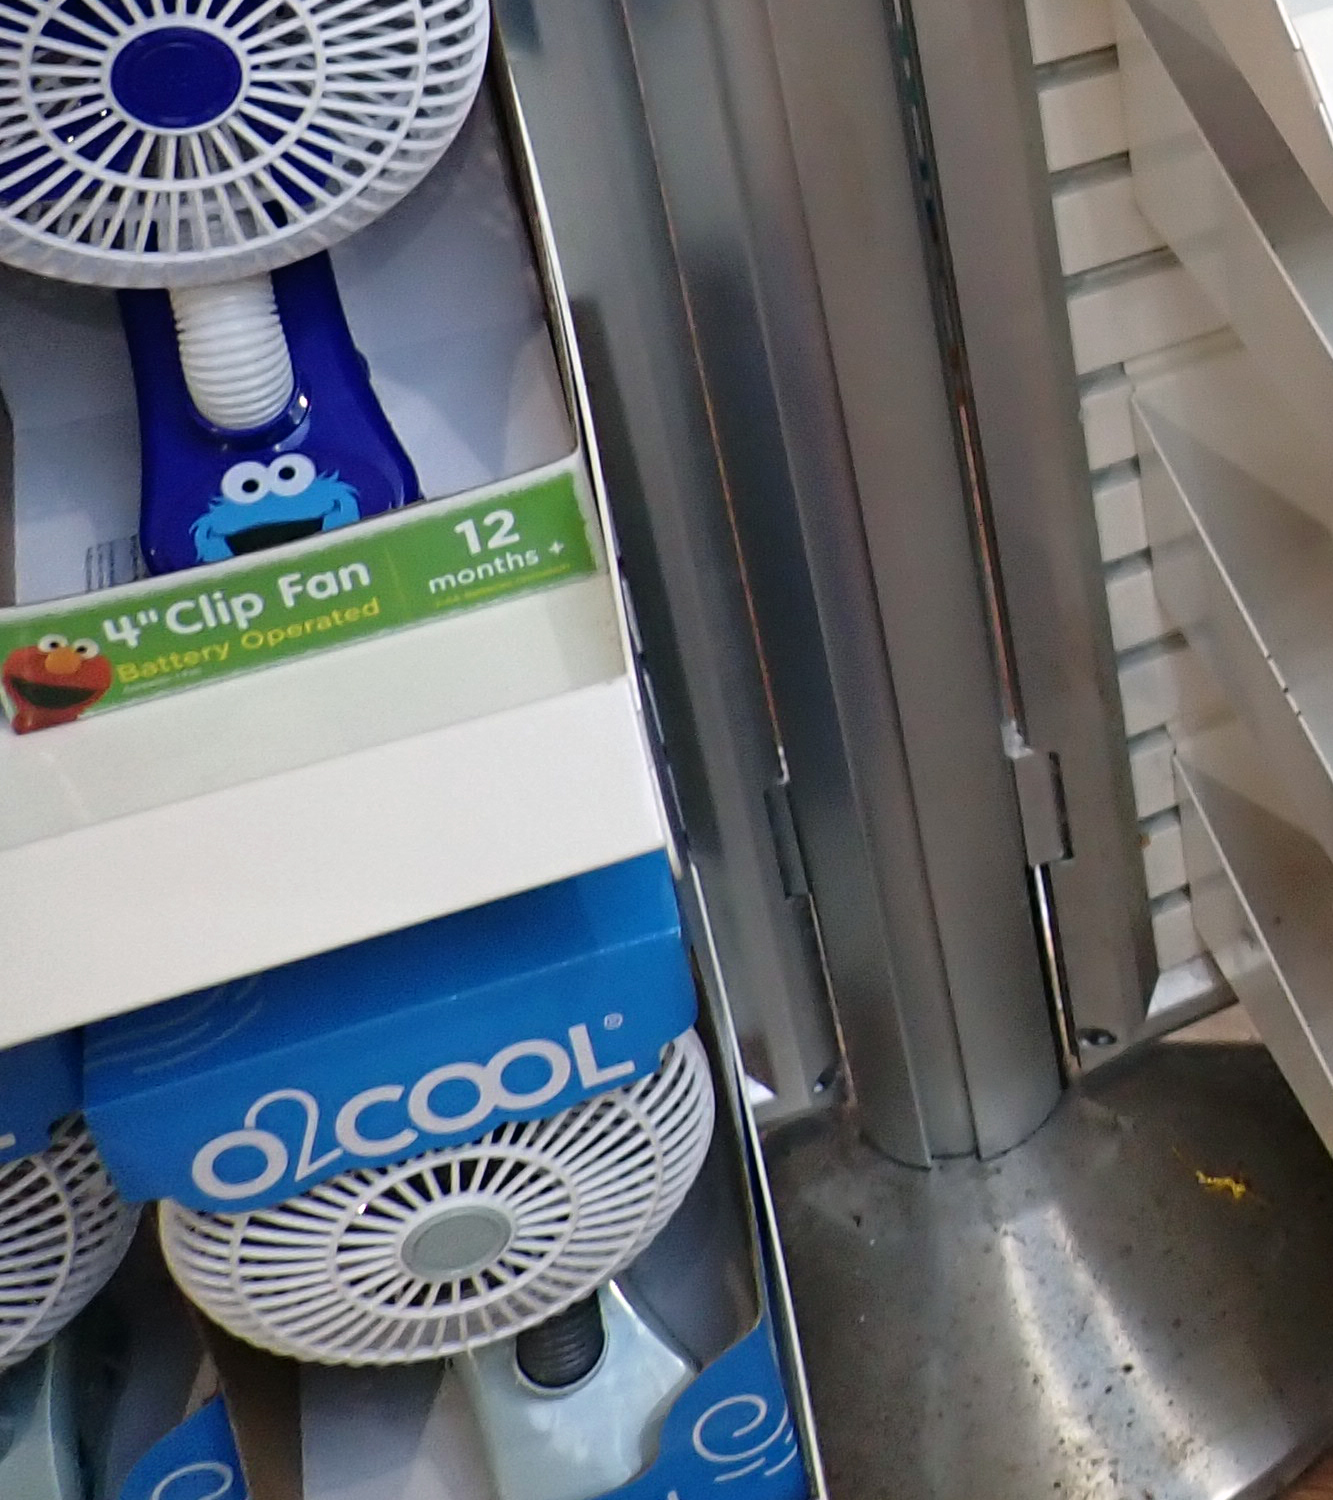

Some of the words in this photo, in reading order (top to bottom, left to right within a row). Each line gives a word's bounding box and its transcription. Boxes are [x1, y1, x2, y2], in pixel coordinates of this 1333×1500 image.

[453, 509, 521, 557] 12
[277, 561, 372, 609] Fan
[428, 549, 540, 595] months
[116, 641, 230, 684] Battery
[240, 597, 382, 650] Operated
